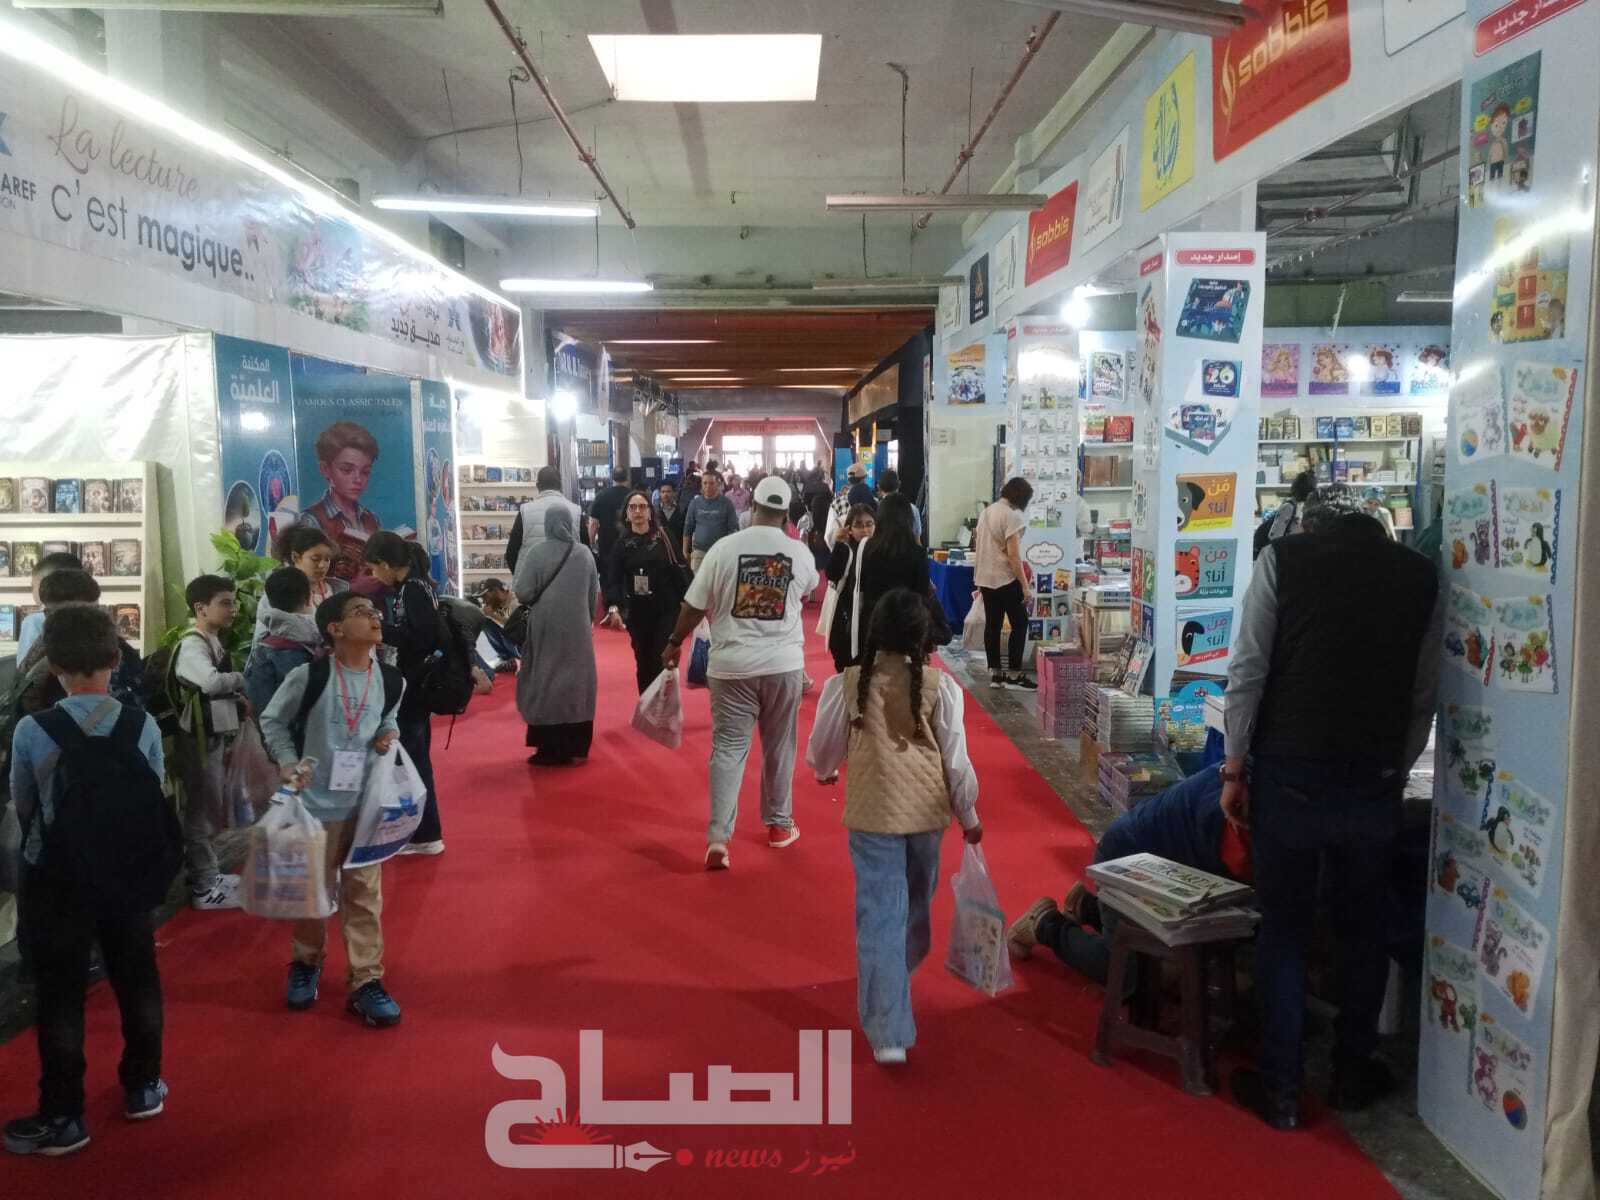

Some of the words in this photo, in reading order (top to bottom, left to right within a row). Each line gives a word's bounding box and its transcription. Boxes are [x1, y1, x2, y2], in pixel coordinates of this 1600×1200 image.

[1238, 0, 1329, 88] sobbis
[1493, 10, 1529, 35] جديد
[48, 95, 100, 175] La
[110, 118, 201, 197] lecture
[1035, 214, 1071, 251] sobbis
